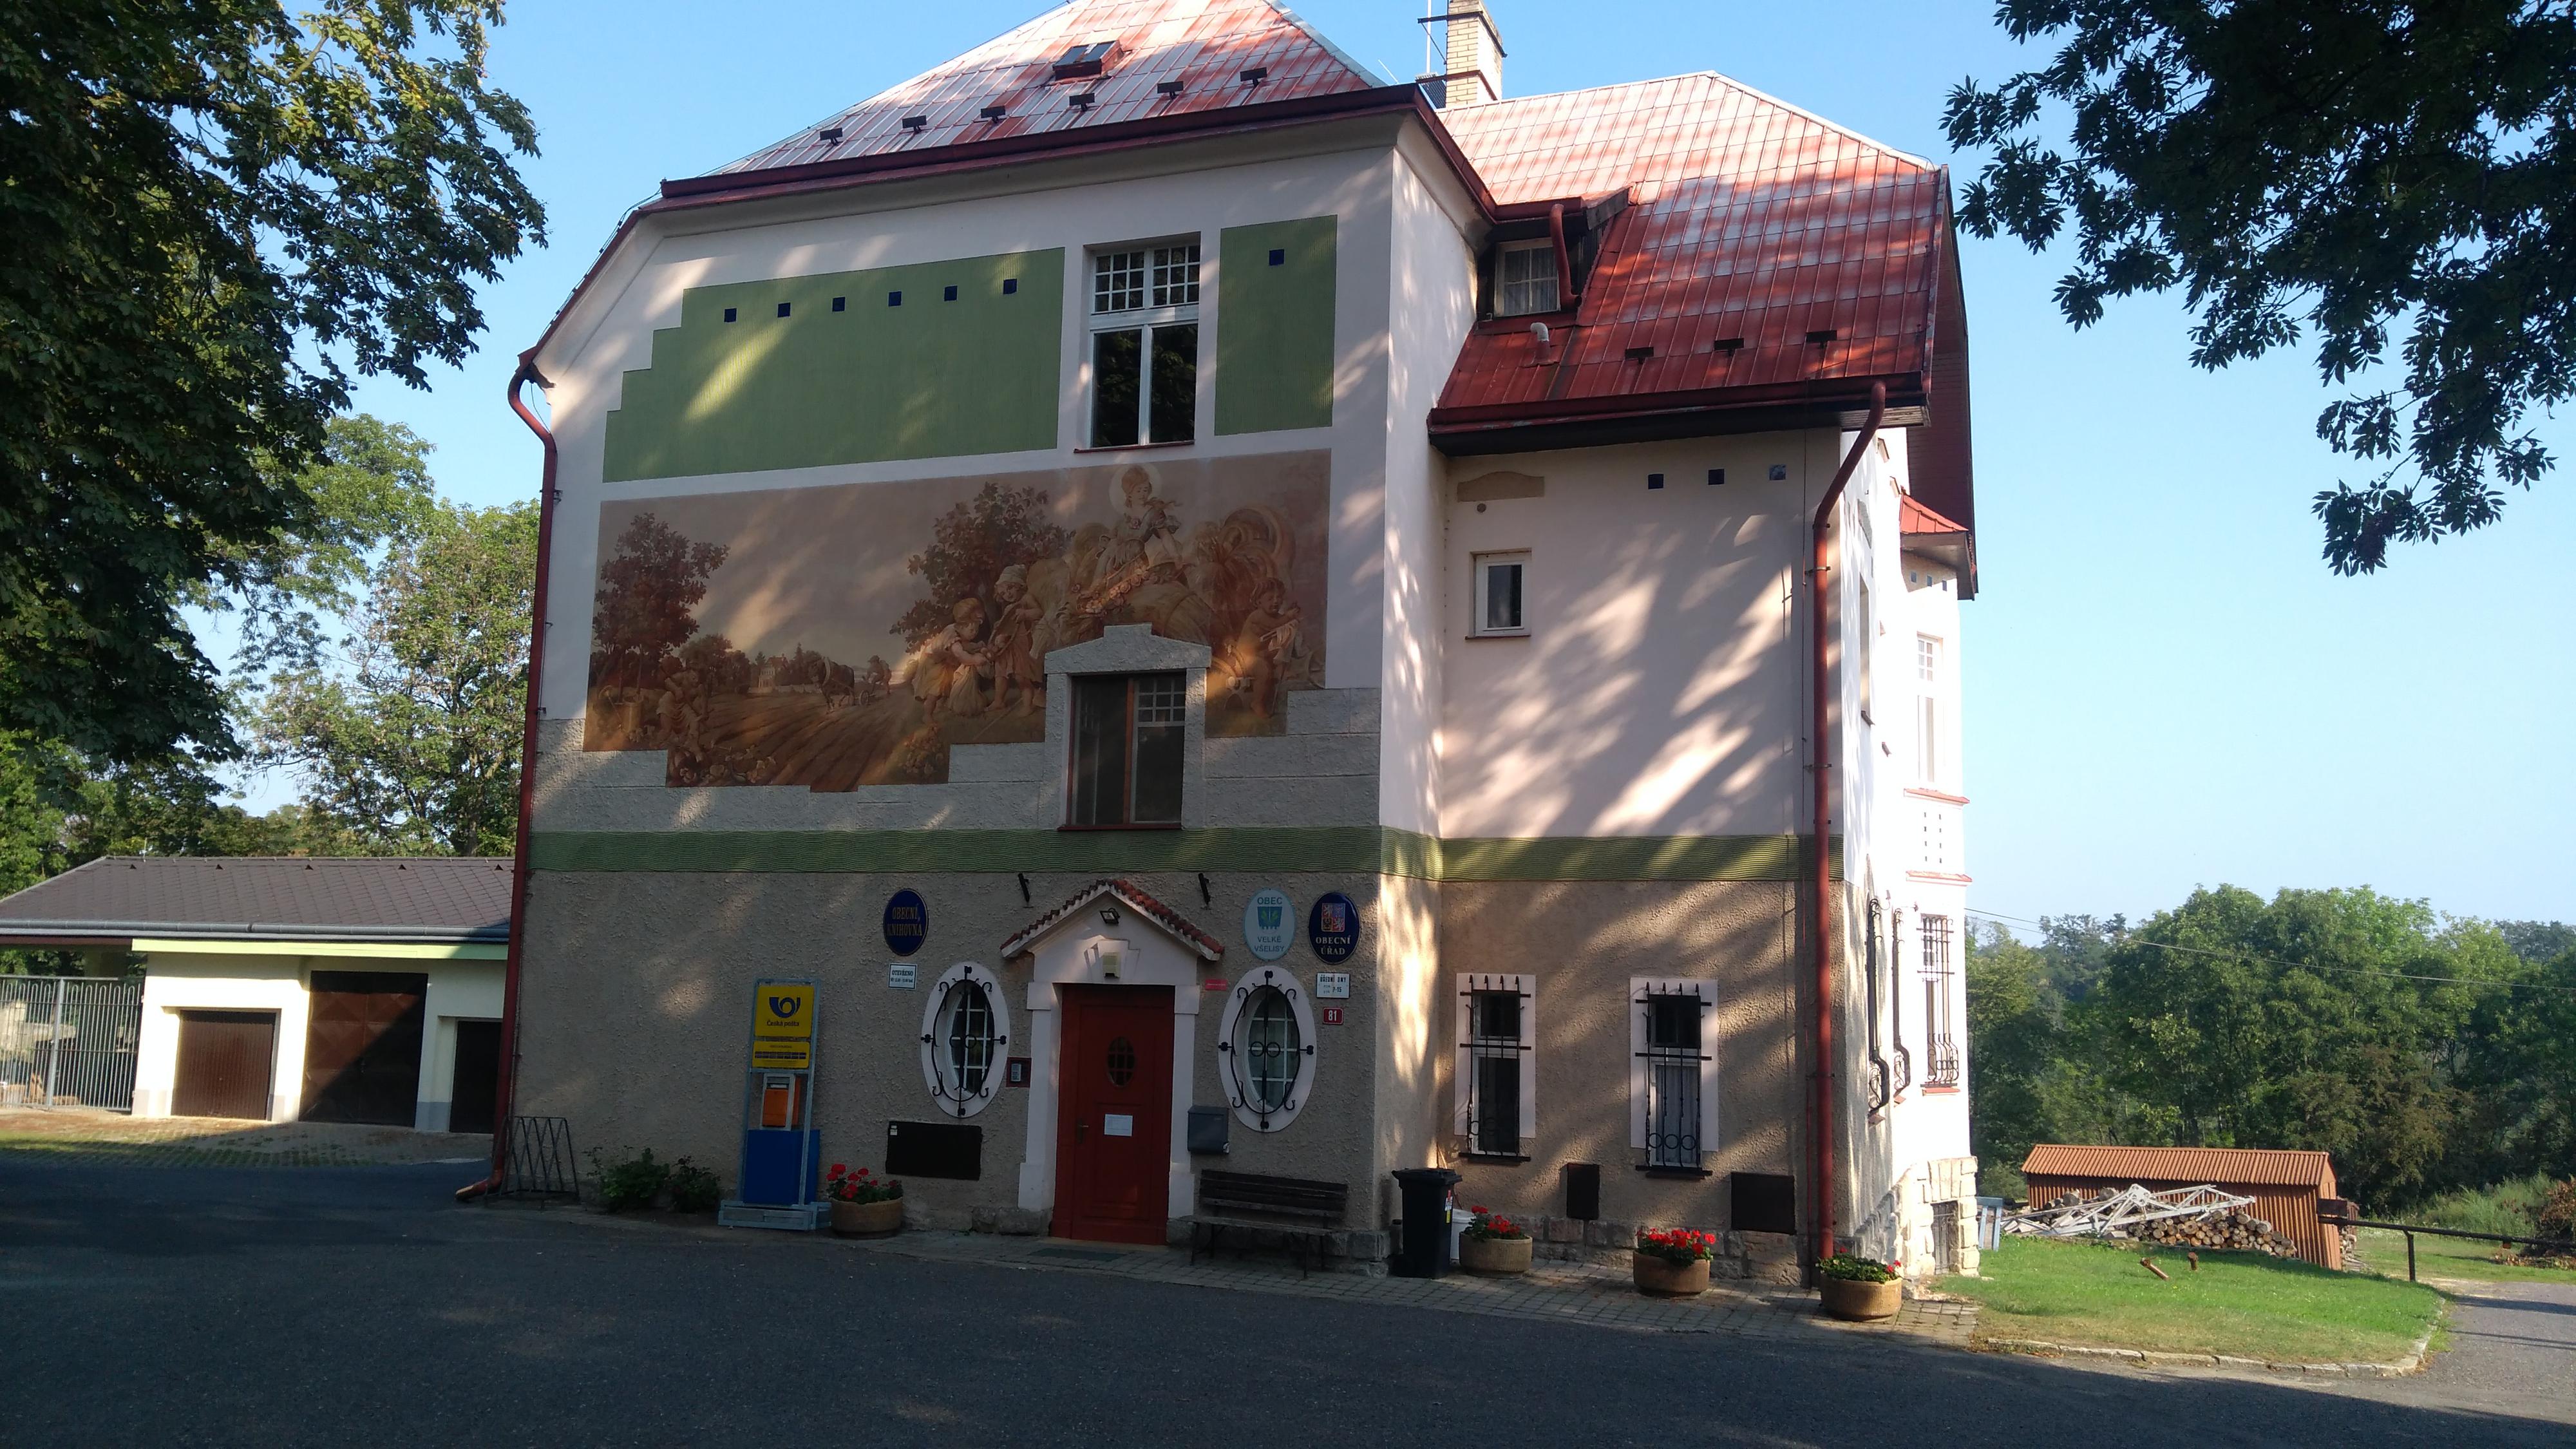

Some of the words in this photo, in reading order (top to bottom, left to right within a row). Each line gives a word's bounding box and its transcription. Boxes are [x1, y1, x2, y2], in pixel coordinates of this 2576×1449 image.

[892, 904, 919, 920] OBECNÍ
[887, 923, 922, 936] KNIHOVNA
[1258, 934, 1282, 943] VELKÉ
[1315, 934, 1351, 944] OBECNÍ
[1320, 945, 1345, 955] ÚŘAD
[1328, 1010, 1338, 1021] 81
